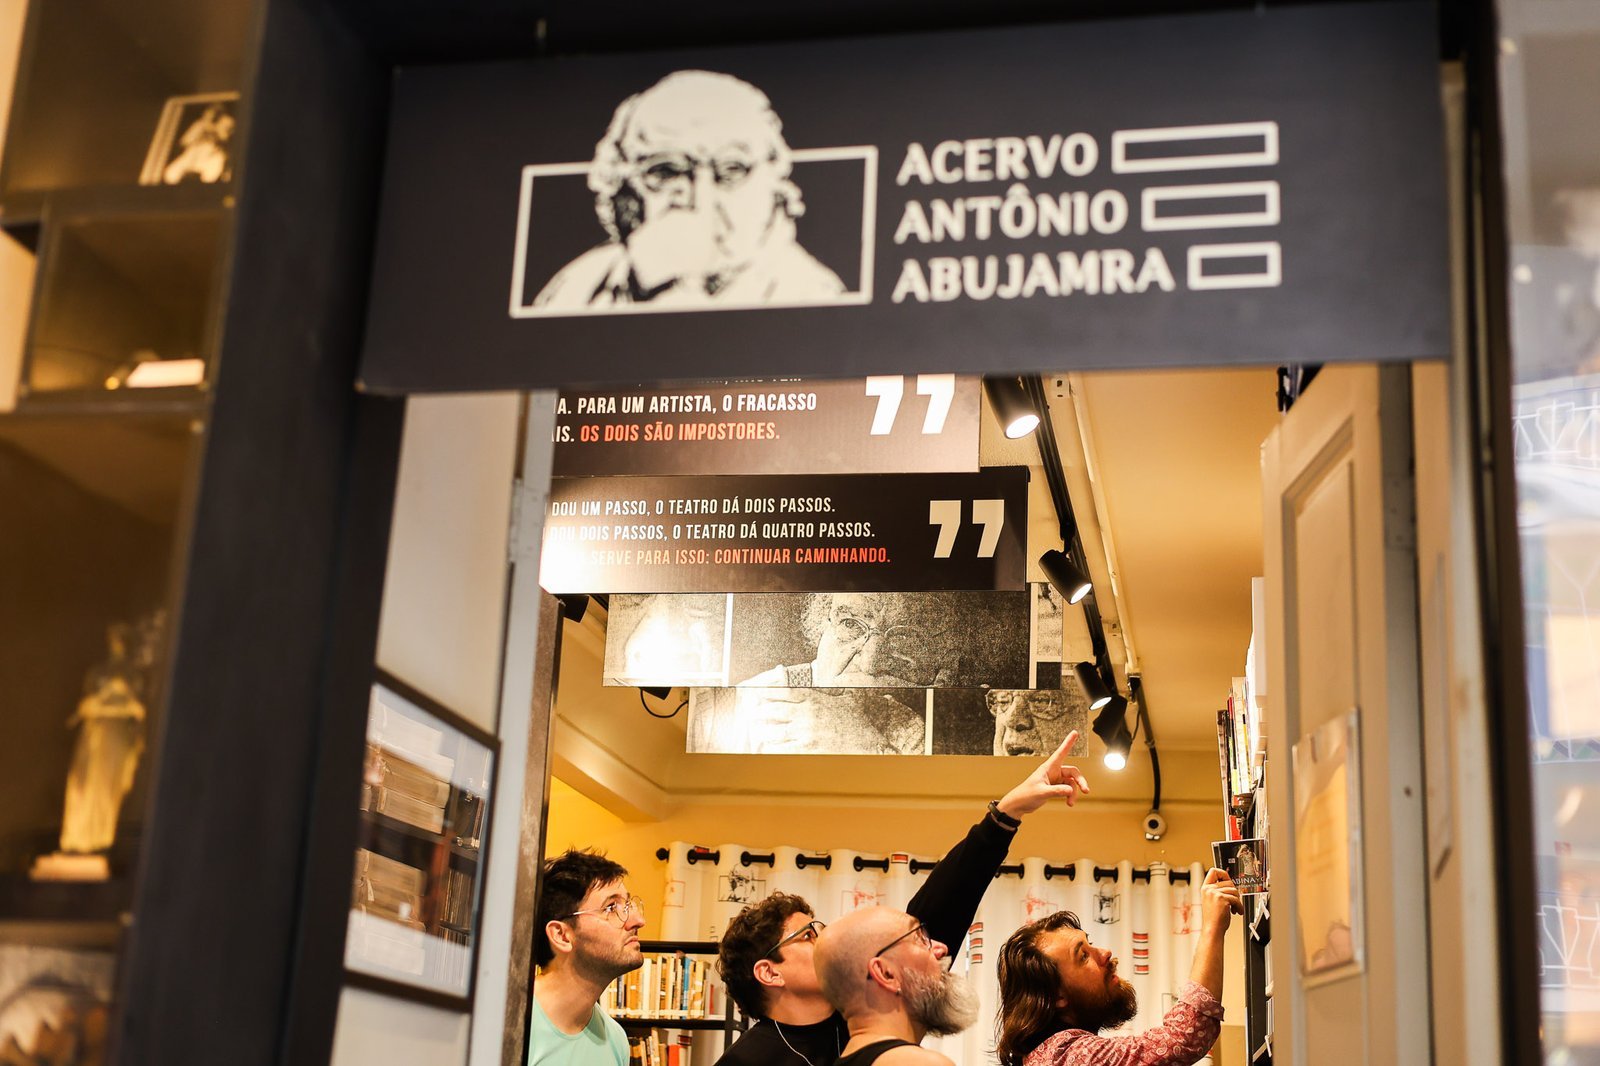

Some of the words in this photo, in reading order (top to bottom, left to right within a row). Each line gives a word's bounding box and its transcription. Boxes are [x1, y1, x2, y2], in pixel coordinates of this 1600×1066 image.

[896, 132, 1099, 186] ACERVO
[893, 182, 1130, 245] ANTÔNIO
[892, 247, 1176, 304] ABUJAMRA
[553, 397, 572, 415] A.
[577, 397, 617, 415] PARA
[621, 396, 645, 414] UM
[649, 394, 717, 415] ARTISTA,
[722, 394, 733, 412] O
[737, 392, 817, 412] FRACASSO
[552, 425, 575, 443] IS.
[580, 425, 600, 443] OS
[604, 424, 640, 442] DOIS
[644, 421, 674, 442] SÃO
[678, 422, 780, 441] IMPOSTORES.
[551, 501, 577, 517] DOU
[581, 500, 601, 516] UM
[605, 500, 651, 517] PASSO,
[655, 499, 664, 515] O
[668, 498, 718, 515] TEATRO
[722, 496, 740, 514] DÁ
[744, 498, 775, 514] DOIS
[780, 497, 836, 513] PASSOS.
[580, 525, 610, 541] DOIS
[613, 524, 668, 541] PASSOS,
[672, 523, 682, 540] O
[685, 523, 735, 540] TEATRO
[740, 520, 758, 539] DÁ
[762, 522, 815, 539] QUATRO
[819, 521, 876, 538] PASSOS.
[591, 550, 632, 566] SERVE
[636, 549, 671, 565] PARA
[675, 548, 710, 565] ISSO:
[714, 547, 791, 565] CONTINUAR
[795, 547, 891, 563] CAMINHANDO.
